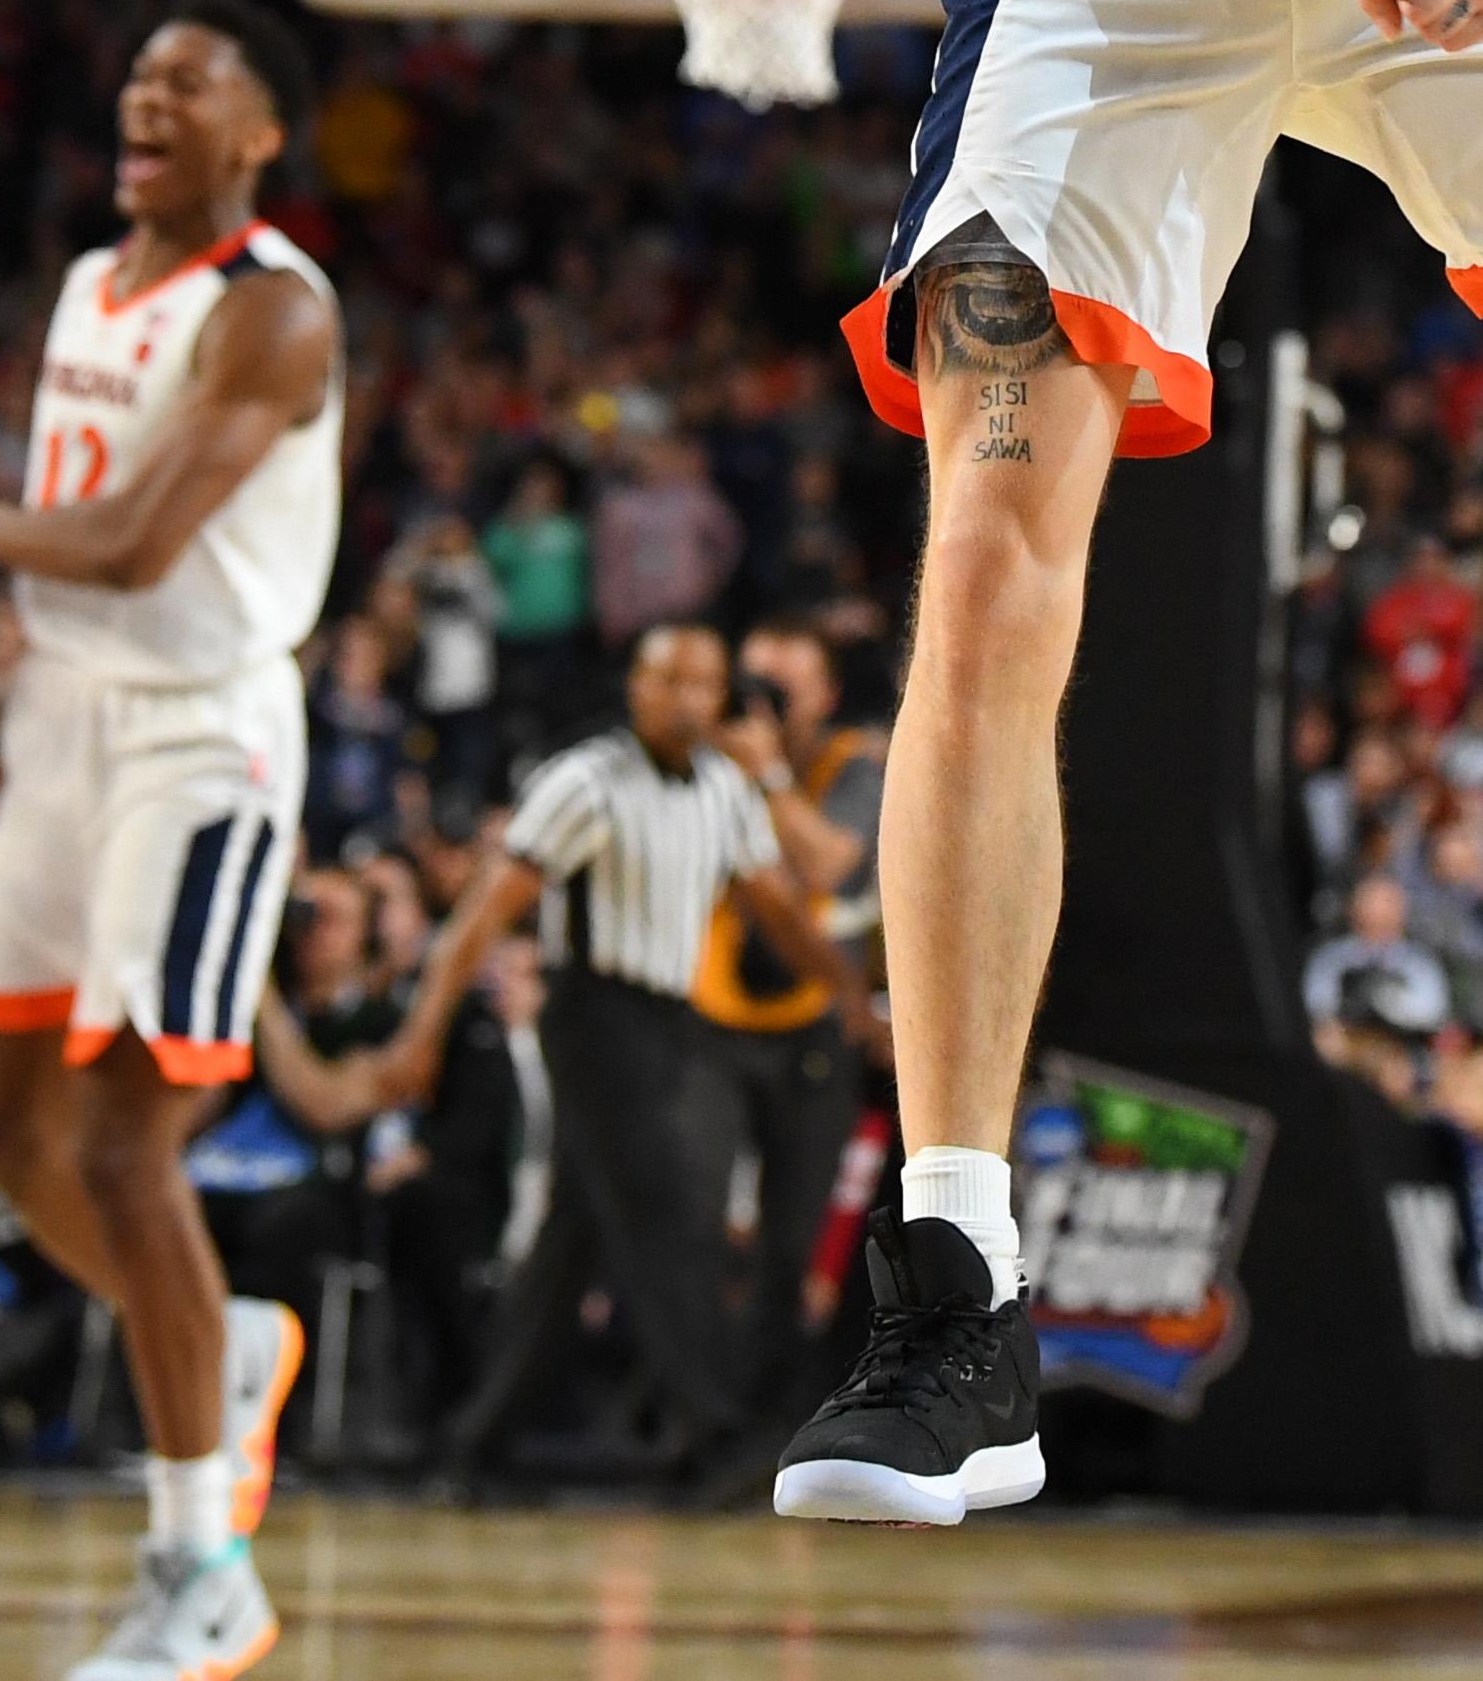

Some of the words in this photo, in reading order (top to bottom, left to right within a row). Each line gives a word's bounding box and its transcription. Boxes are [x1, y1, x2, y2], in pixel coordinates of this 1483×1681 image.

[978, 381, 1029, 411] SISI
[988, 412, 1015, 435] NI
[971, 436, 1033, 464] SAWA
